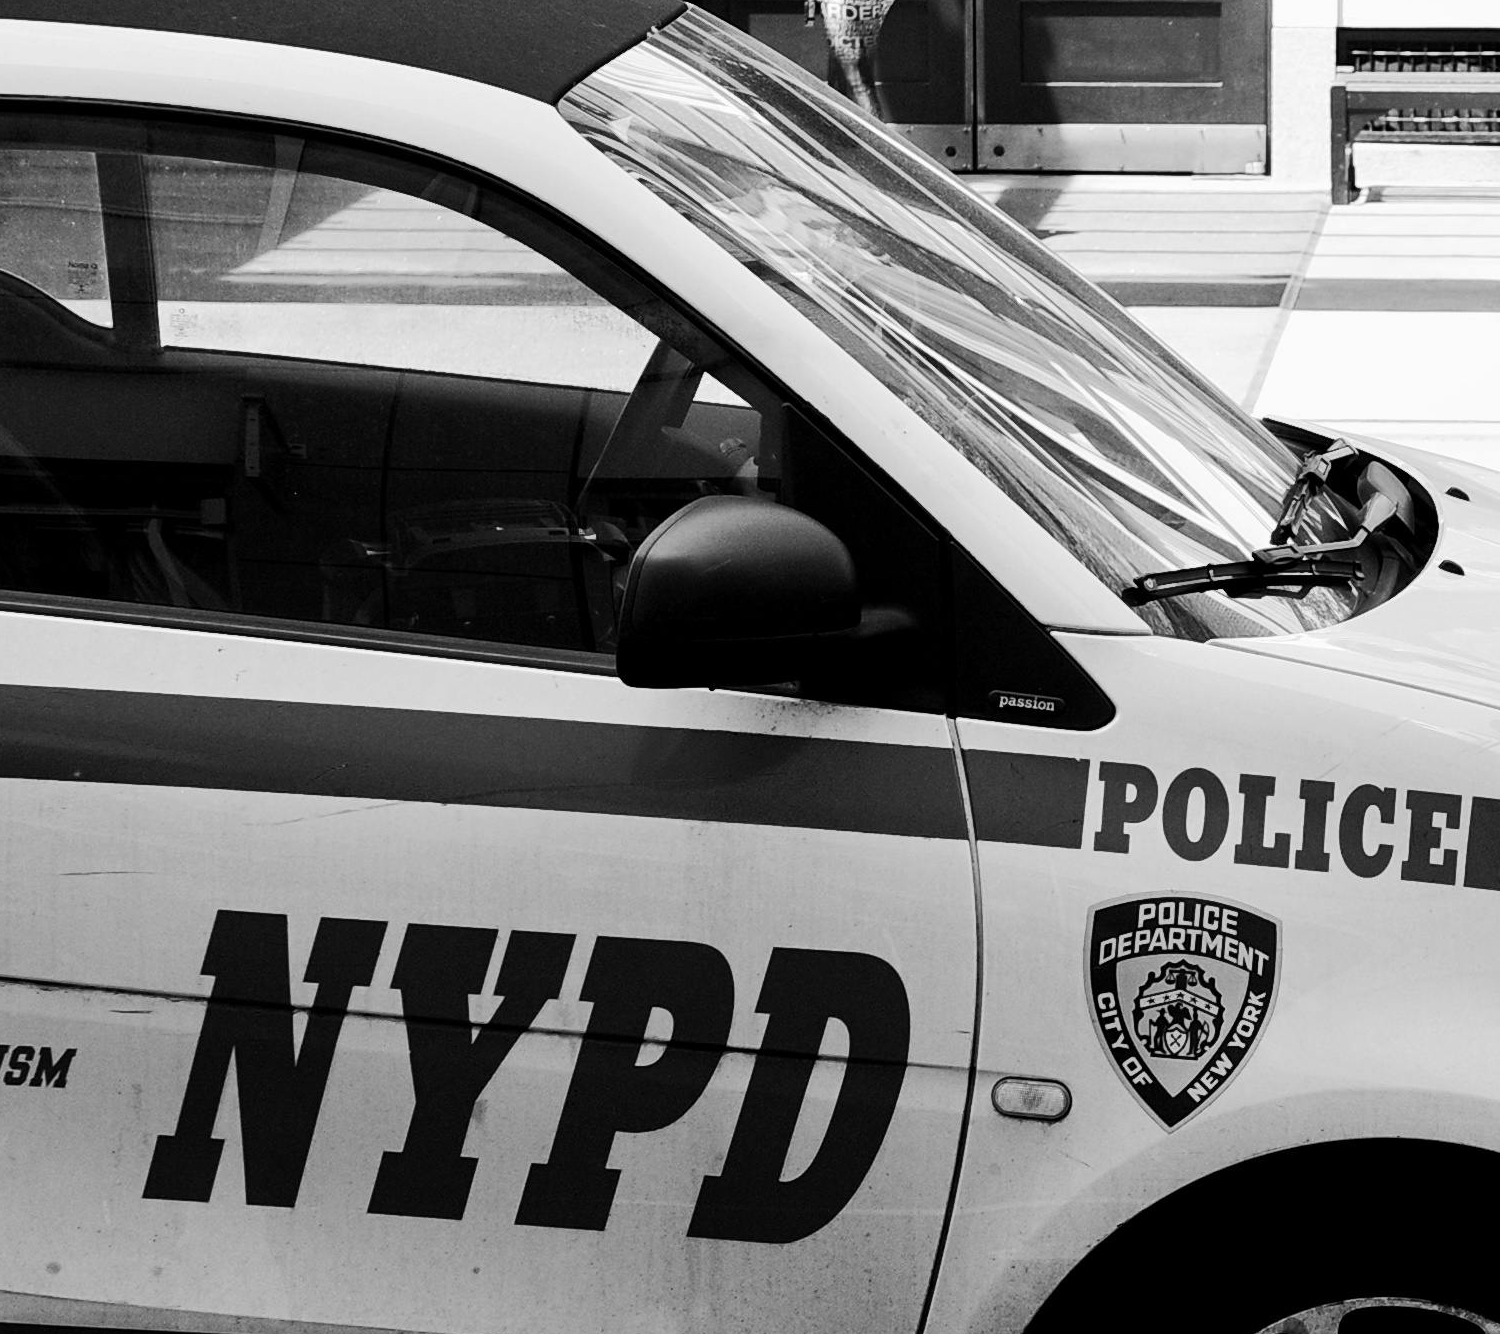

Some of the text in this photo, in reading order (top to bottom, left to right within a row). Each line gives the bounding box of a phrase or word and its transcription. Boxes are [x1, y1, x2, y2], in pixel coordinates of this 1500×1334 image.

[999, 692, 1056, 714] passion
[1093, 760, 1463, 887] POLICE
[1098, 926, 1270, 976] DEPARTMENT
[1137, 901, 1239, 935] POLICE
[141, 908, 911, 1245] NYPD
[1096, 991, 1154, 1088] CITY OF
[1186, 990, 1267, 1104] NEW YORK
